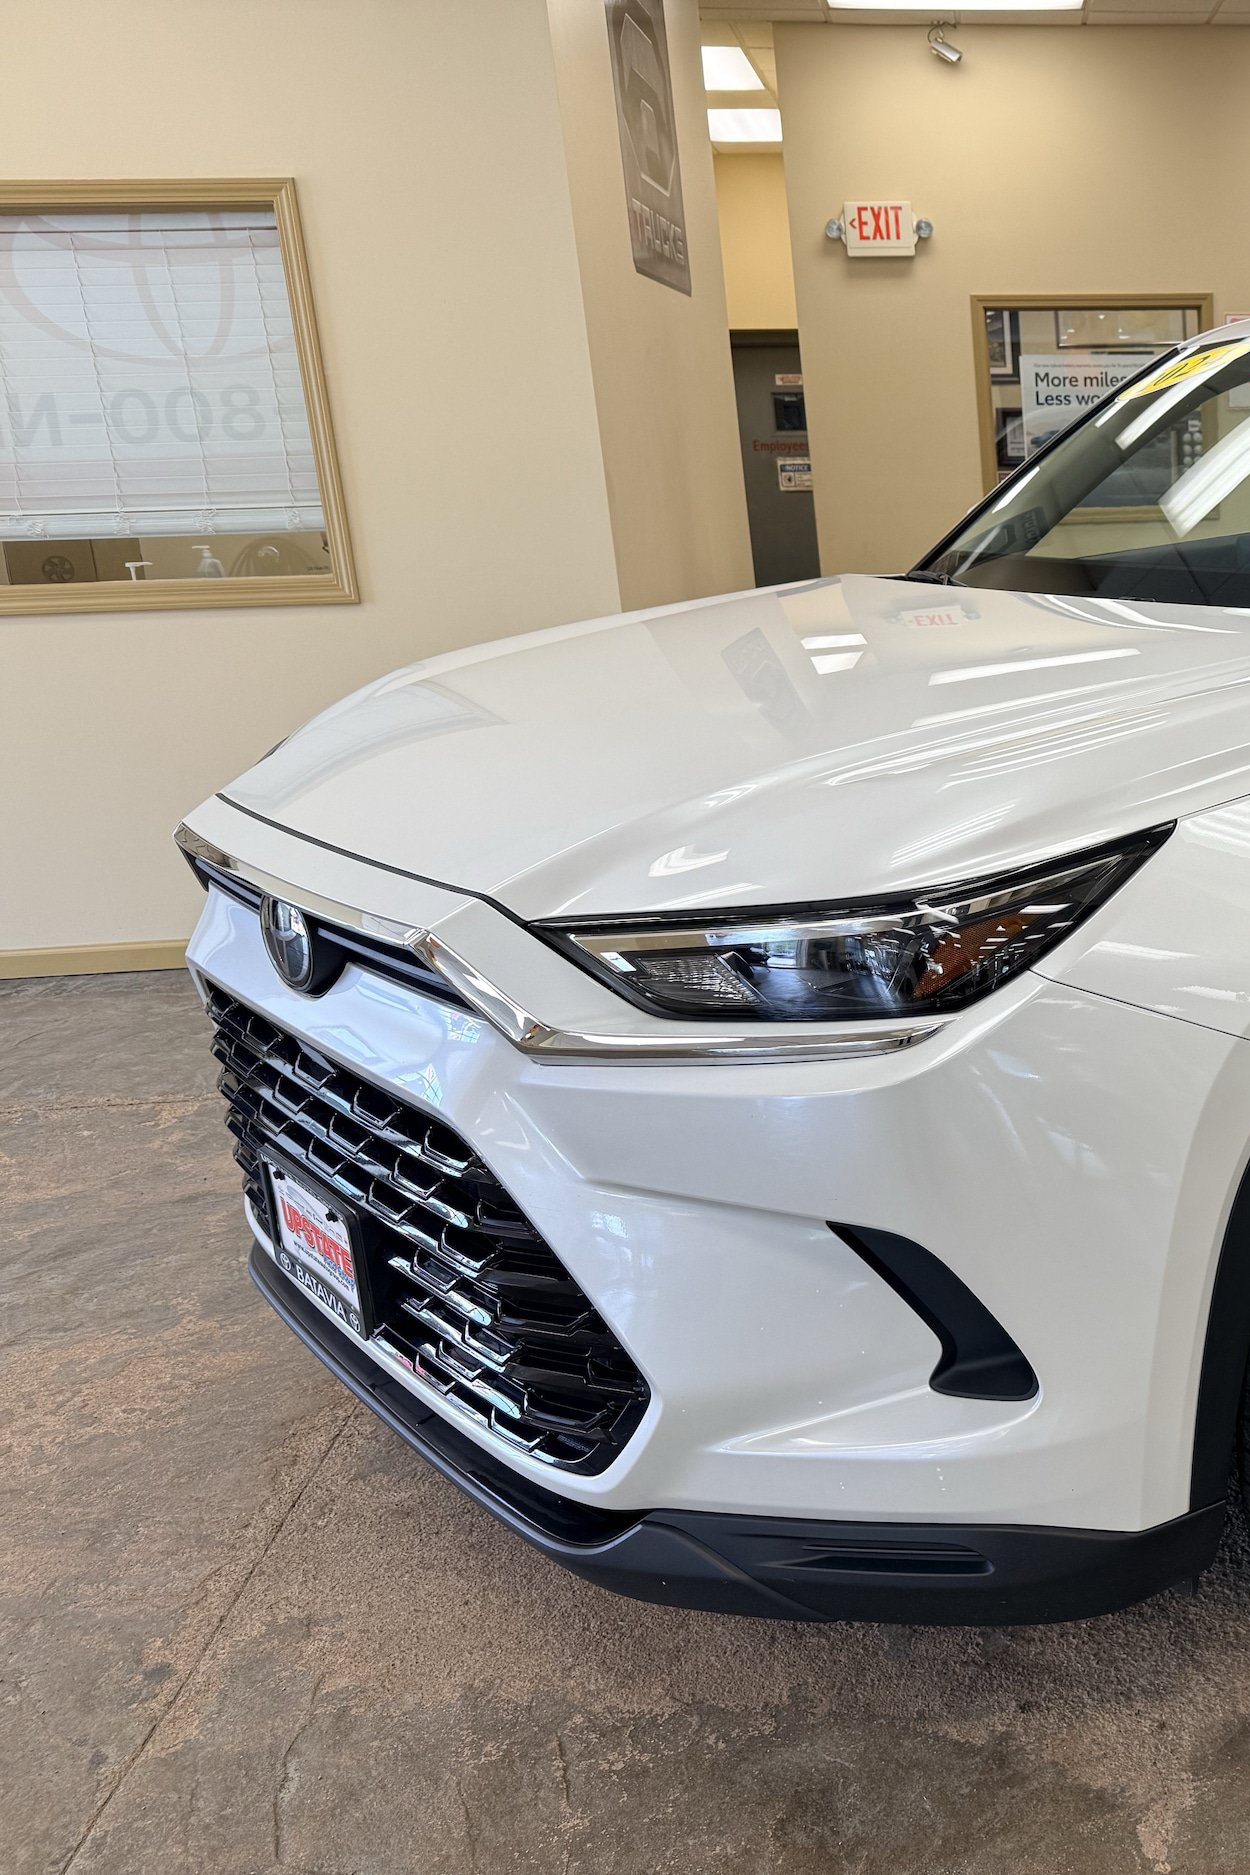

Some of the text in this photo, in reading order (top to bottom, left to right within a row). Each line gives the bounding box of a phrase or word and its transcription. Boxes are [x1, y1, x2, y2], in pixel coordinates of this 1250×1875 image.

[631, 197, 685, 265] TRUCKS
[856, 205, 903, 241] EXIT
[1034, 372, 1077, 388] More
[1036, 391, 1101, 406] Less wo
[280, 1196, 355, 1279] UPSTATE
[295, 1264, 348, 1322] BATAVIA
